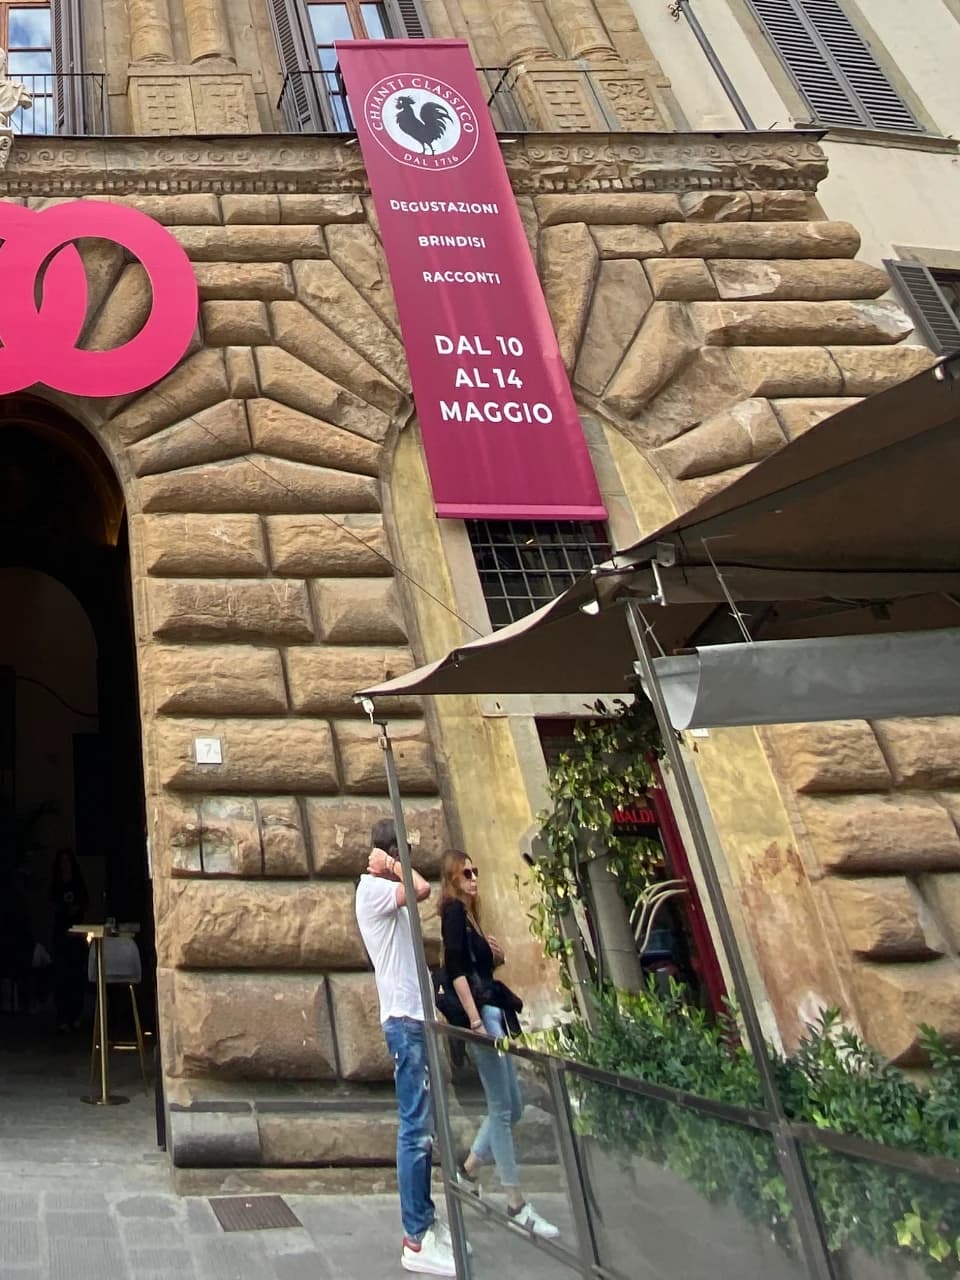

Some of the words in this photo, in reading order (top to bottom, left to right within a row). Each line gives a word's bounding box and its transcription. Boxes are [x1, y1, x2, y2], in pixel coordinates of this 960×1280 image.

[370, 78, 404, 131] CHIANTI
[411, 78, 474, 133] CLASSICO
[404, 153, 429, 166] DAL
[434, 155, 460, 167] 1716
[390, 200, 499, 214] DEGUSTAZIONI
[418, 235, 486, 248] BRINDISI
[423, 271, 501, 284] RACCONTI
[434, 335, 491, 355] DAL
[495, 336, 524, 357] 10
[455, 368, 490, 388] AL
[492, 368, 523, 388] 14
[440, 400, 553, 424] MAGGIO
